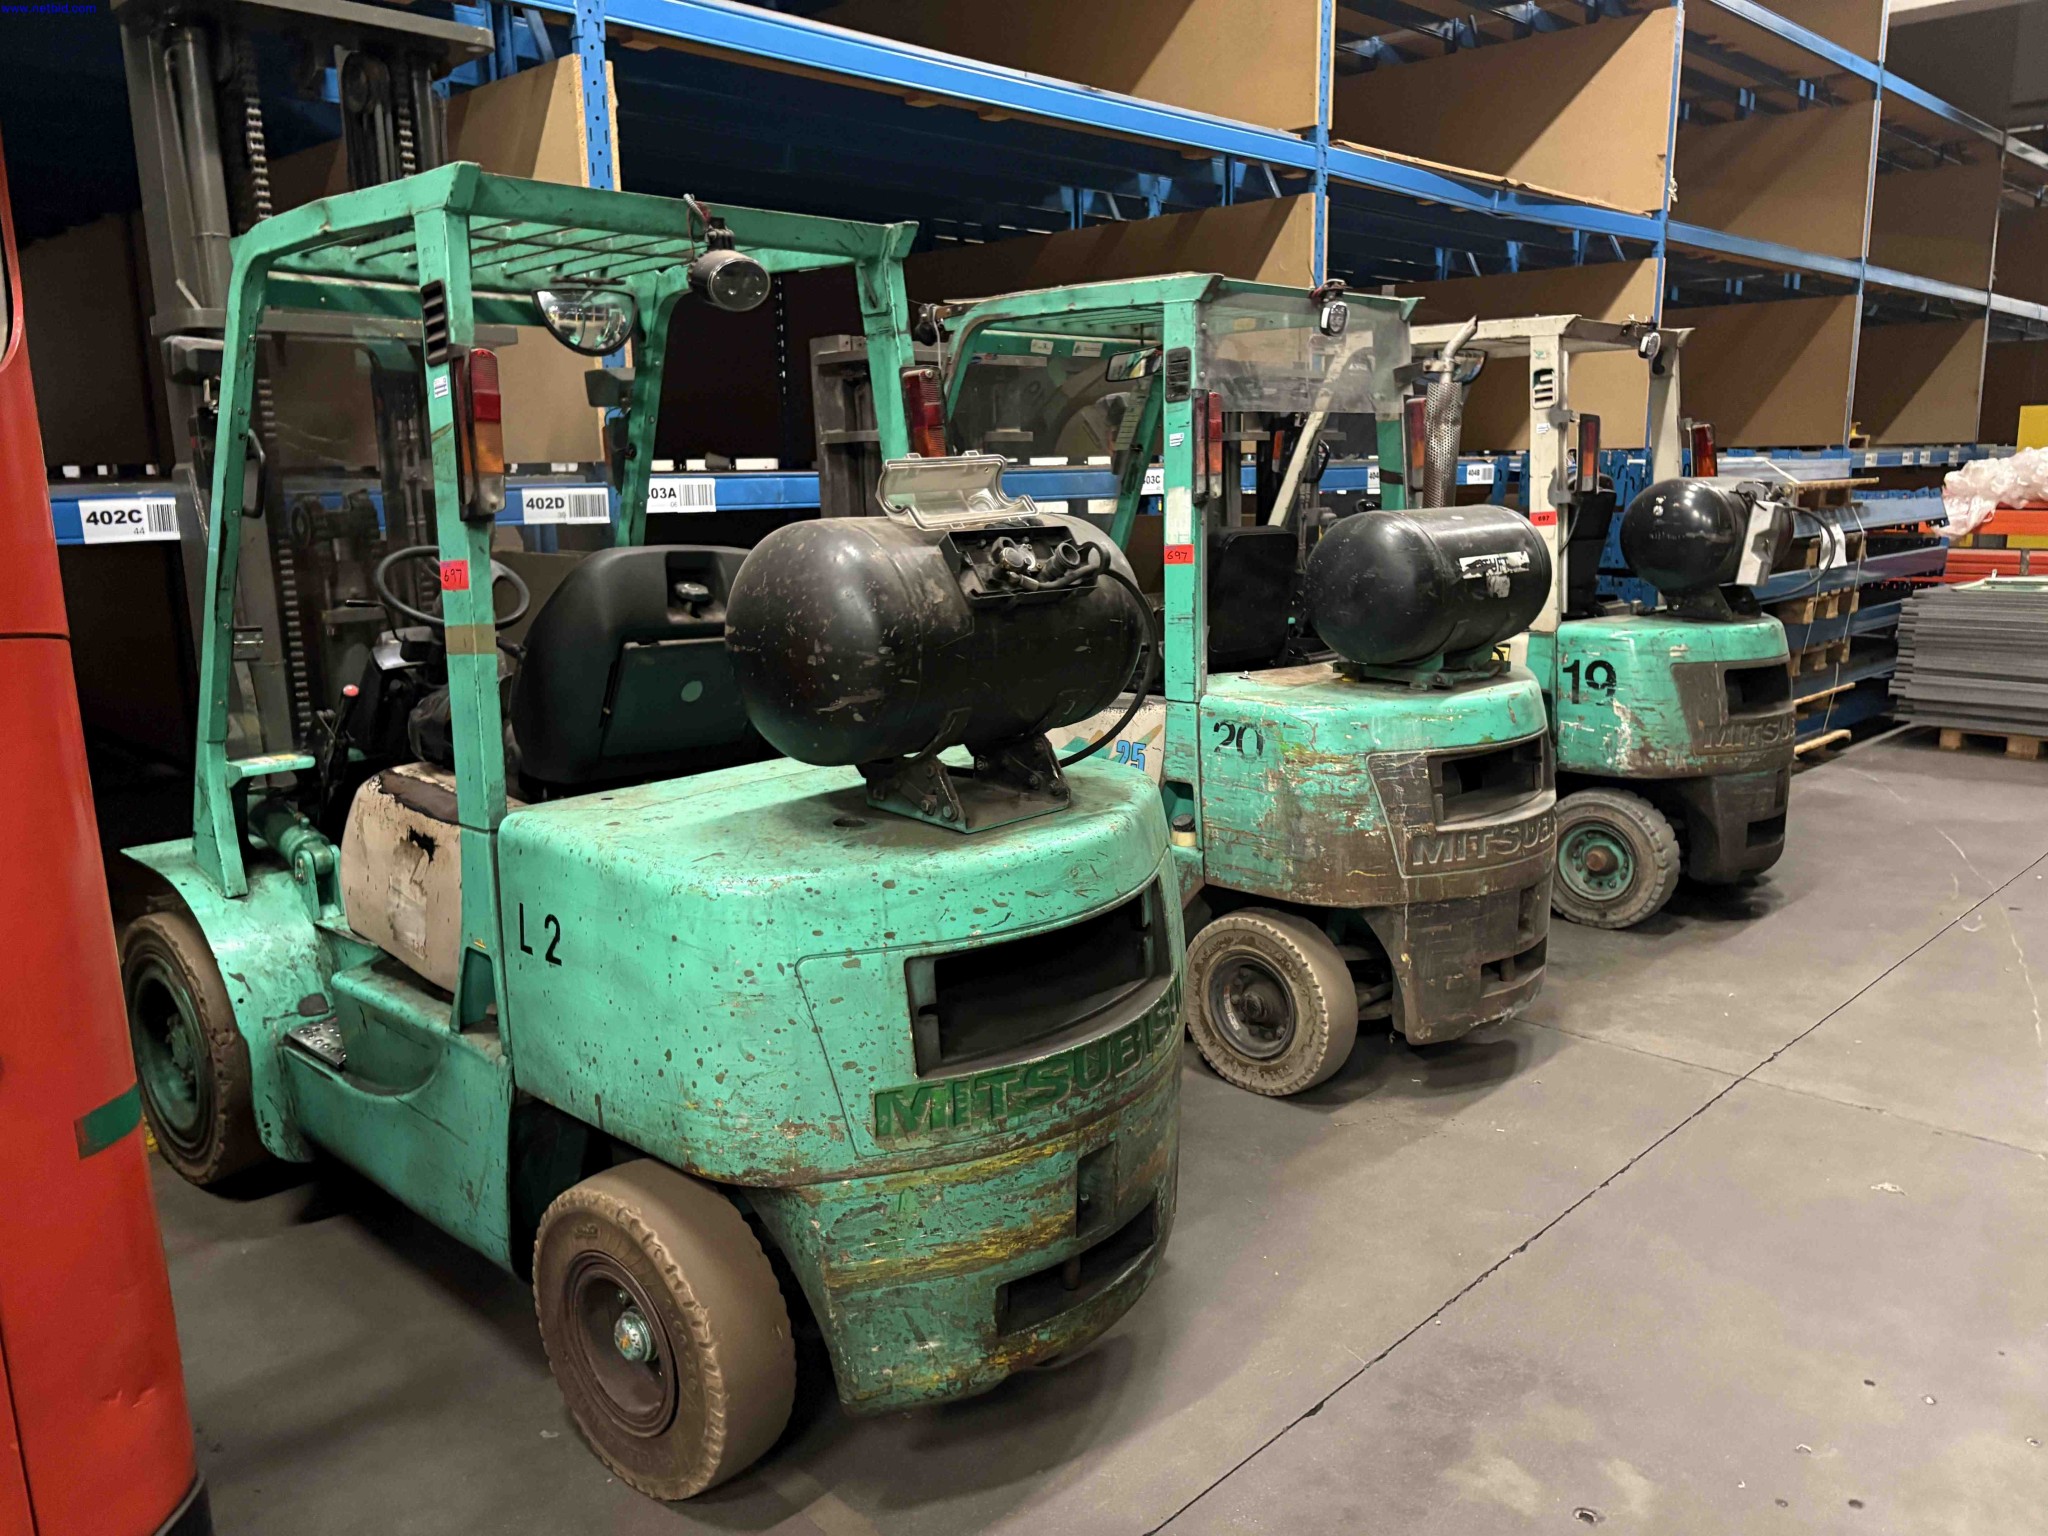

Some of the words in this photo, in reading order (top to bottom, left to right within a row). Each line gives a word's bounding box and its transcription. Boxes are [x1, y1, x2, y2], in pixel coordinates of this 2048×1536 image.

[1144, 475, 1160, 484] 03C
[1369, 472, 1380, 480] 404
[648, 487, 677, 499] 03A
[526, 497, 565, 510] 402D
[86, 509, 143, 525] 402C
[133, 527, 145, 535] 44
[1166, 551, 1188, 561] 697
[444, 569, 462, 584] 697
[1563, 659, 1617, 706] 19
[1213, 721, 1264, 761] 20
[1116, 739, 1147, 772] 25
